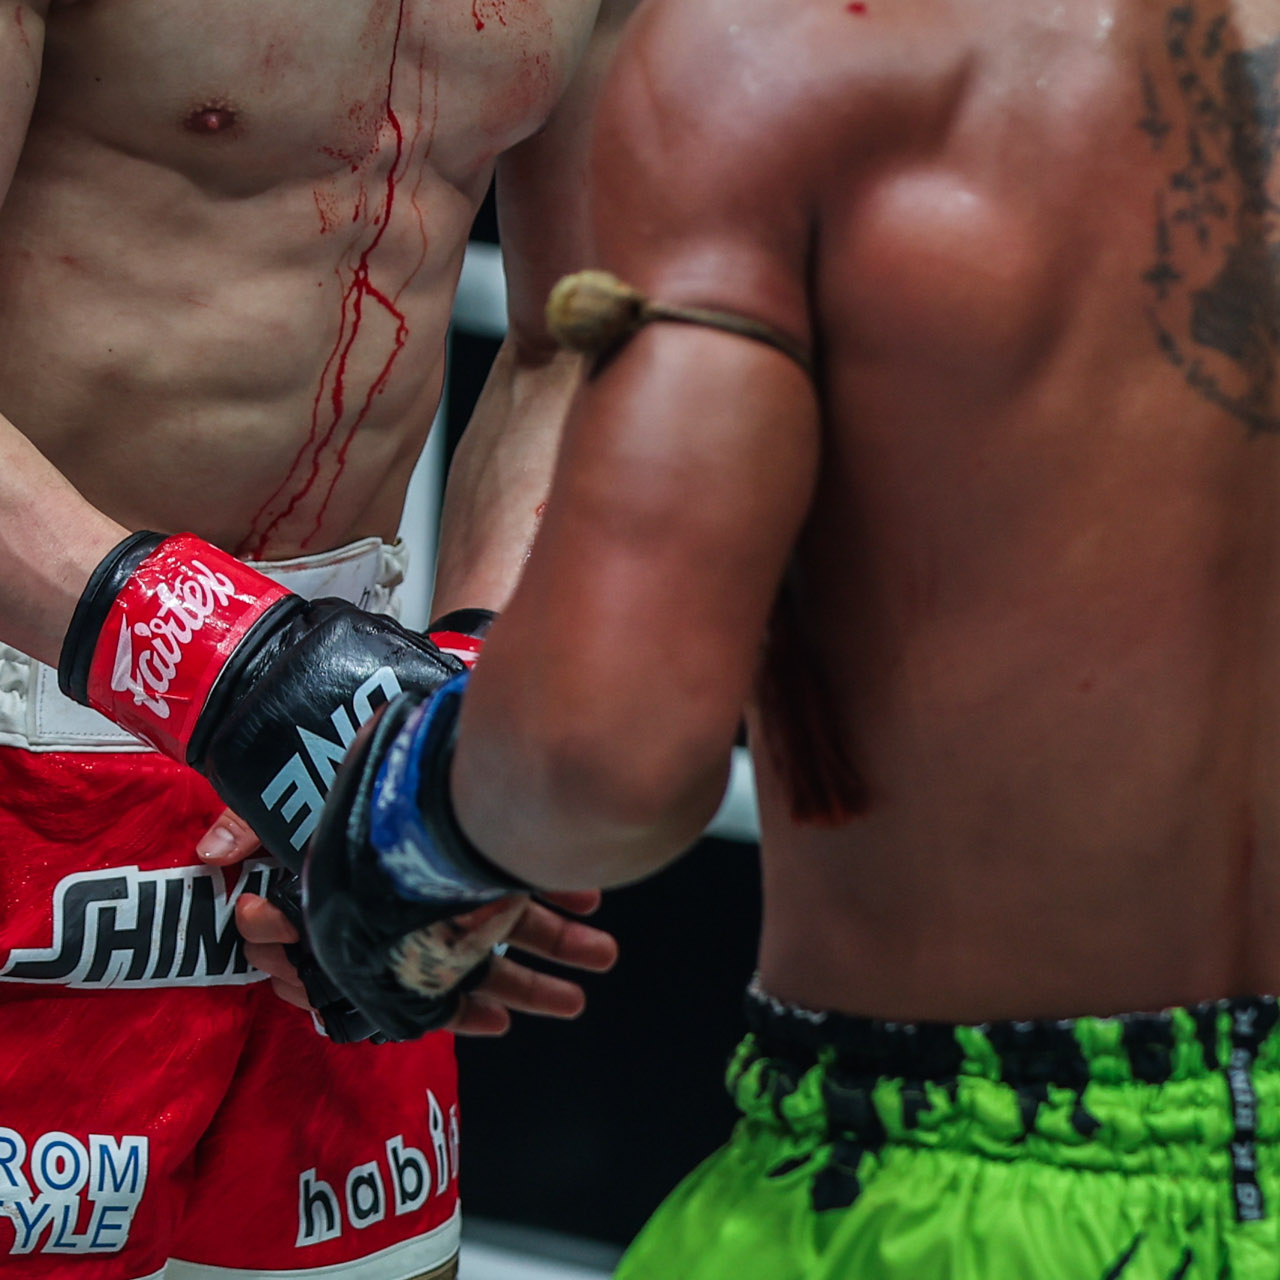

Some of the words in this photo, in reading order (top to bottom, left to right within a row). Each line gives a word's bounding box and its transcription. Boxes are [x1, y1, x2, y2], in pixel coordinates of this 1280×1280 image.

[110, 559, 236, 720] Fairtex
[260, 665, 403, 852] ONE
[300, 1098, 459, 1240] habi
